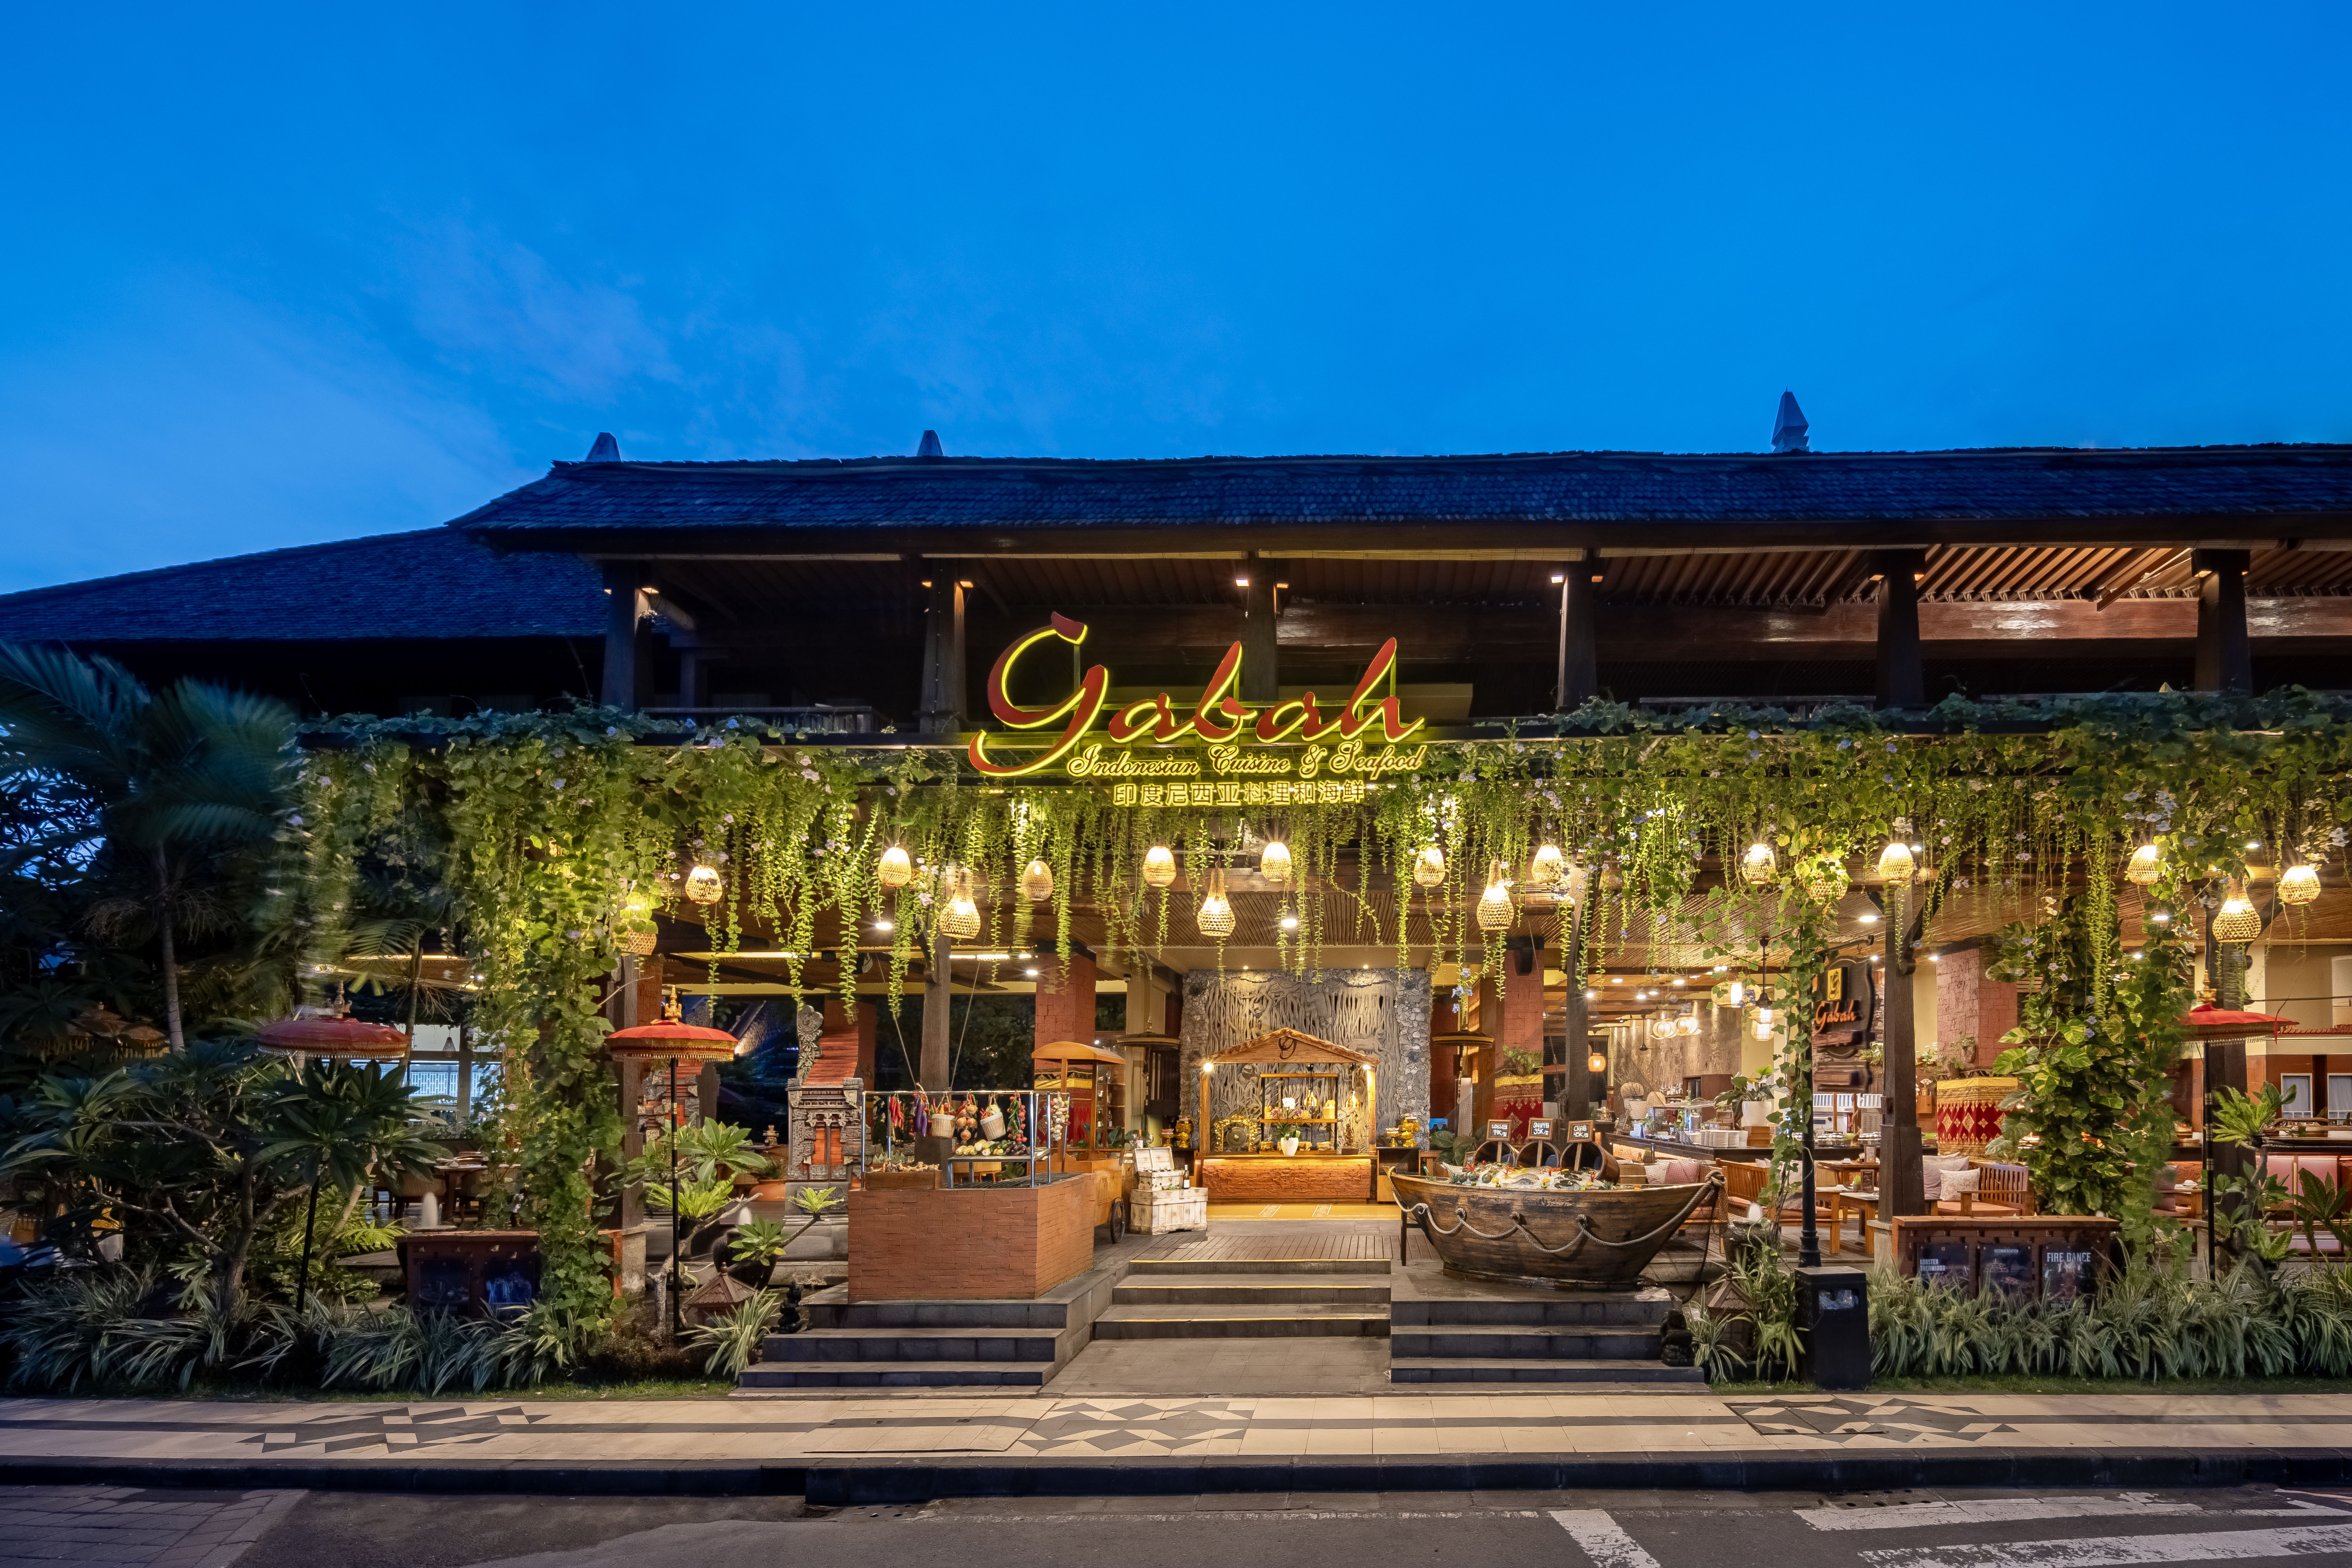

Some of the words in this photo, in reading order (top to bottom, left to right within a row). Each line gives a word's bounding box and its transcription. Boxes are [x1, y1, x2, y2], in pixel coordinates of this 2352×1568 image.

[968, 611, 1425, 777] Gabah
[1067, 743, 1200, 777] Indonesian
[1208, 744, 1291, 776] Cuisine
[1299, 744, 1328, 779] &
[1329, 739, 1428, 780] Seafood
[1113, 780, 1365, 806] 印度尼西亚料理和海鲜
[1815, 999, 1856, 1034] Gabah
[2047, 1253, 2063, 1262] FIRE
[2067, 1253, 2091, 1262] DANCE
